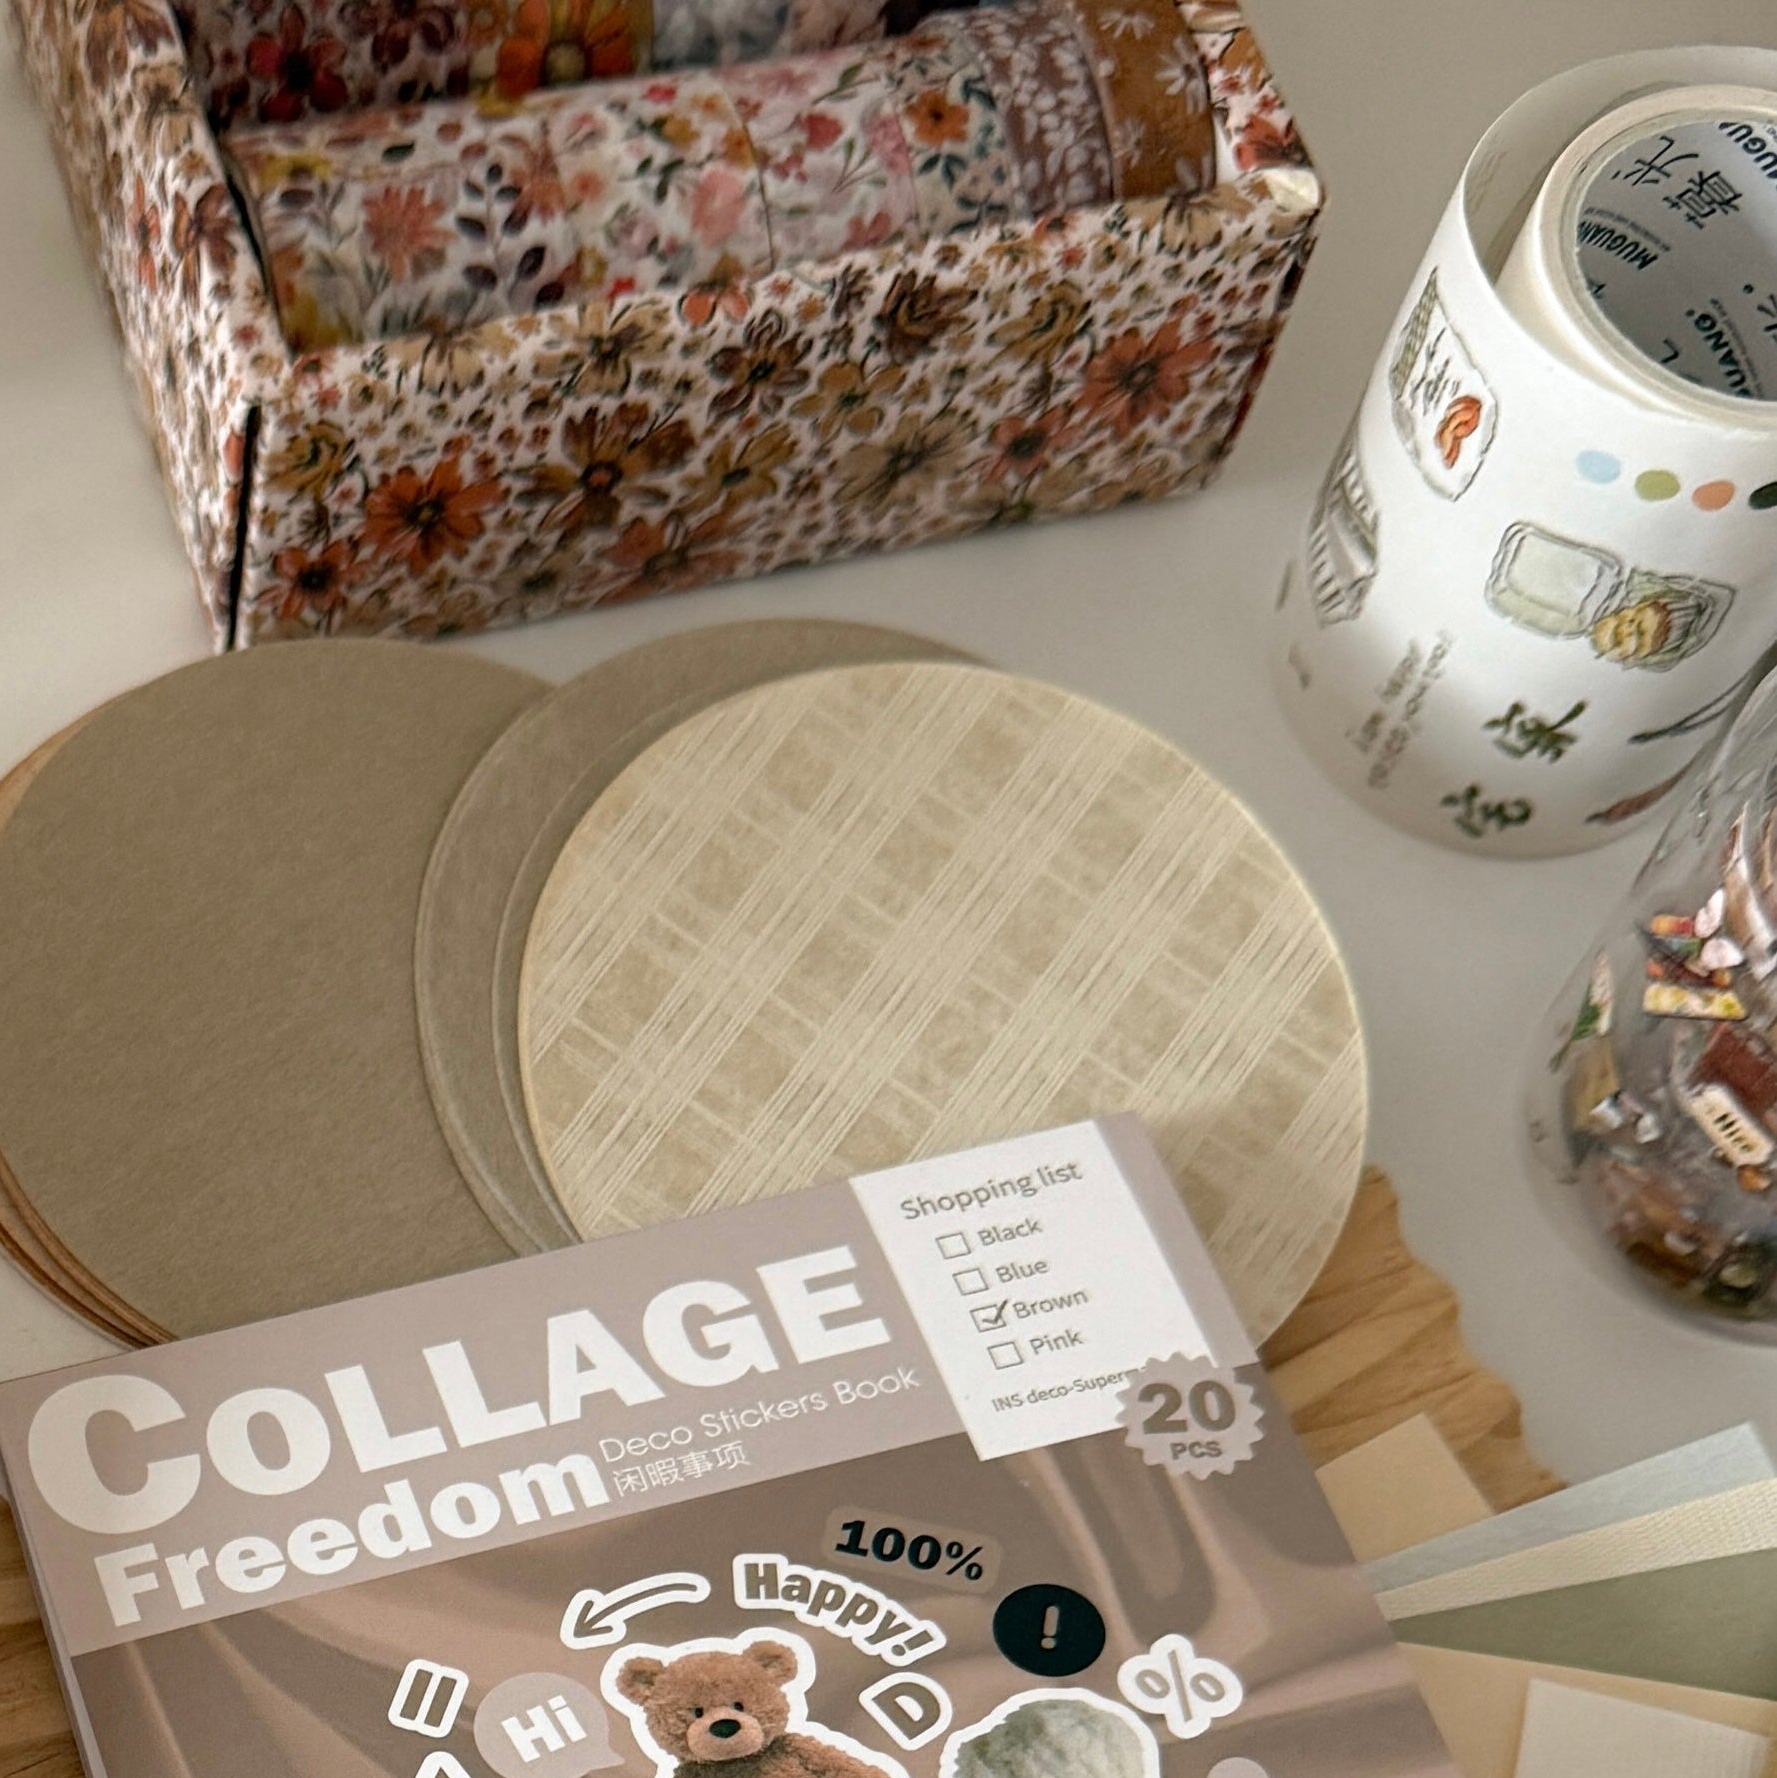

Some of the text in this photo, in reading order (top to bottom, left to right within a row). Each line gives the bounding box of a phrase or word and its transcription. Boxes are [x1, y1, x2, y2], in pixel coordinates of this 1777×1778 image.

[900, 1160, 1083, 1220] Shopping list
[977, 1218, 1043, 1247] Black
[996, 1257, 1049, 1284] Blue
[1012, 1289, 1089, 1320] Brown
[1029, 1328, 1083, 1357] Pink
[26, 1245, 891, 1534] COLLAGE
[599, 1366, 920, 1463] Deco Stickers Book
[991, 1389, 1024, 1413] INS
[1137, 1380, 1237, 1435] 20
[612, 1440, 751, 1497] 闲暇事项
[1171, 1438, 1222, 1460] PCS
[94, 1450, 610, 1627] Freedom
[834, 1517, 987, 1582] 100%
[743, 1560, 937, 1659] Happy!
[499, 1693, 584, 1765] Hi
[869, 1679, 943, 1743] D
